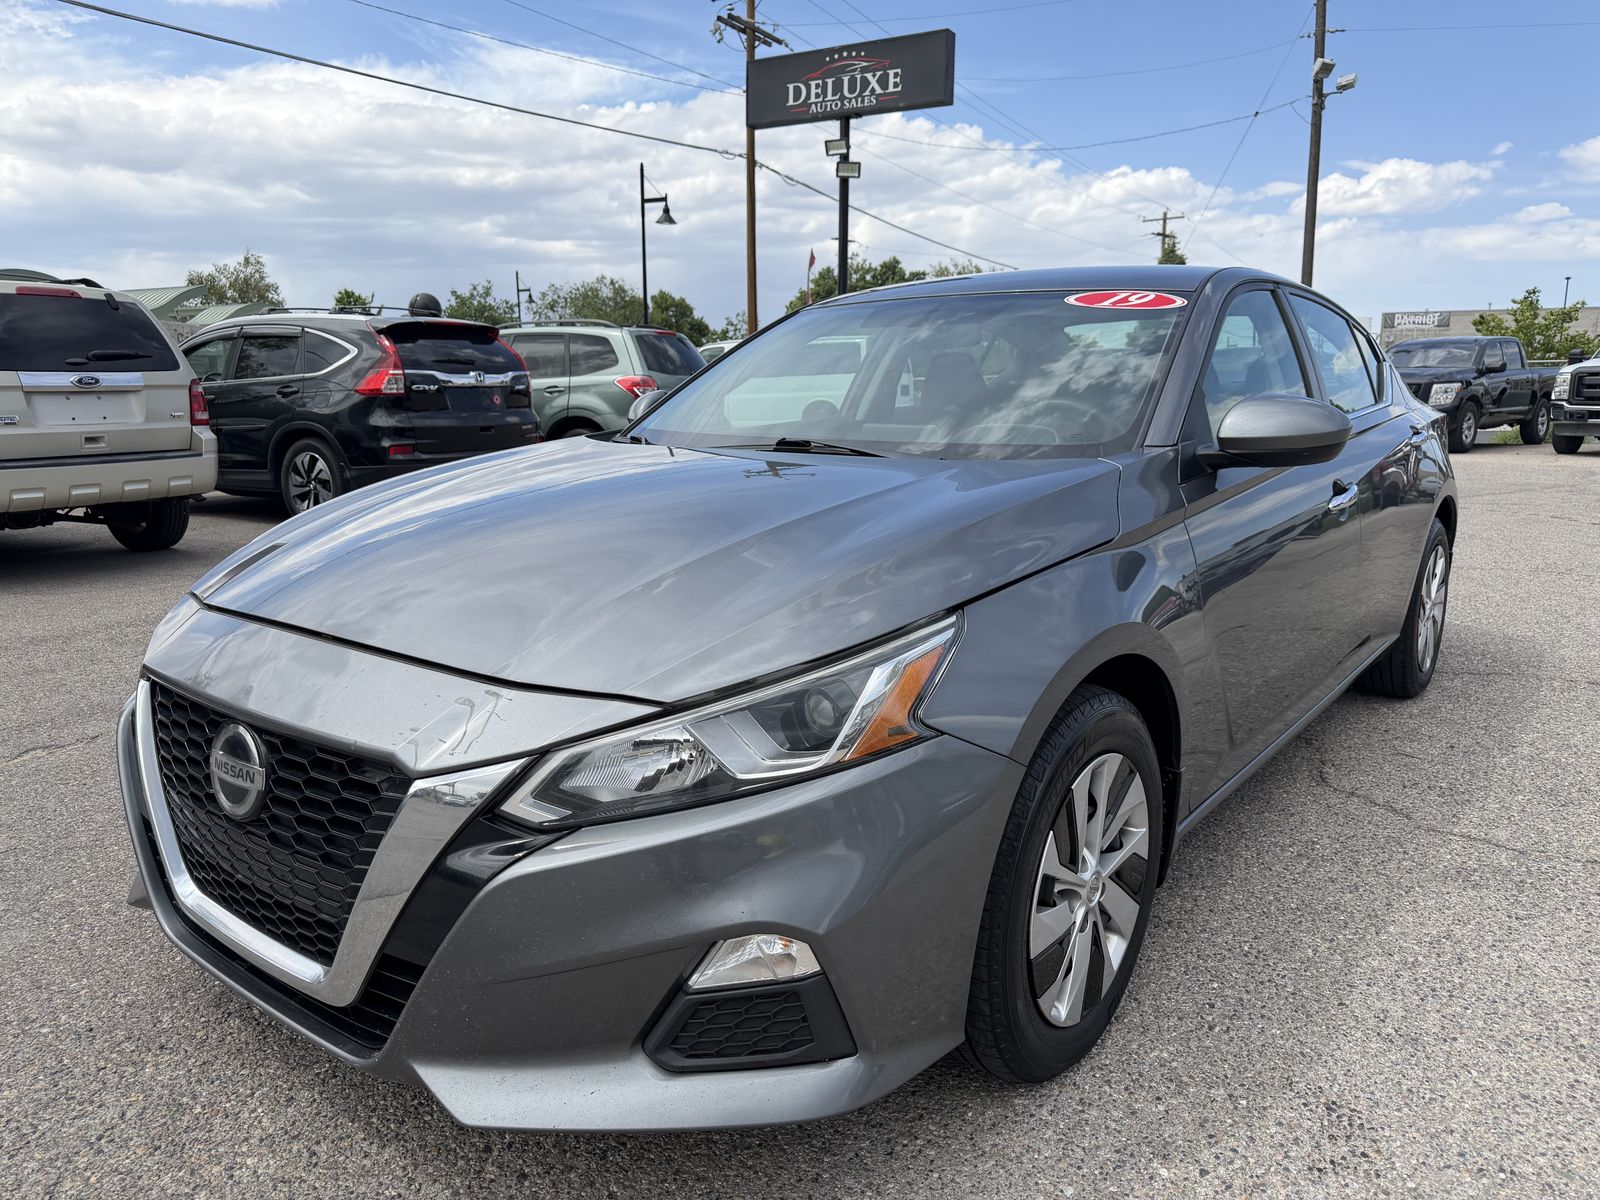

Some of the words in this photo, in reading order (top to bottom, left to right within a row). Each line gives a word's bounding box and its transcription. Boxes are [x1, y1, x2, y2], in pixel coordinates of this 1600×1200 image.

[786, 68, 902, 106] DELUXE
[809, 100, 841, 114] AUTO
[843, 95, 877, 109] SALES
[1093, 292, 1156, 306] 19
[1394, 312, 1440, 326] PATRIOT
[214, 756, 255, 784] NISSAN
